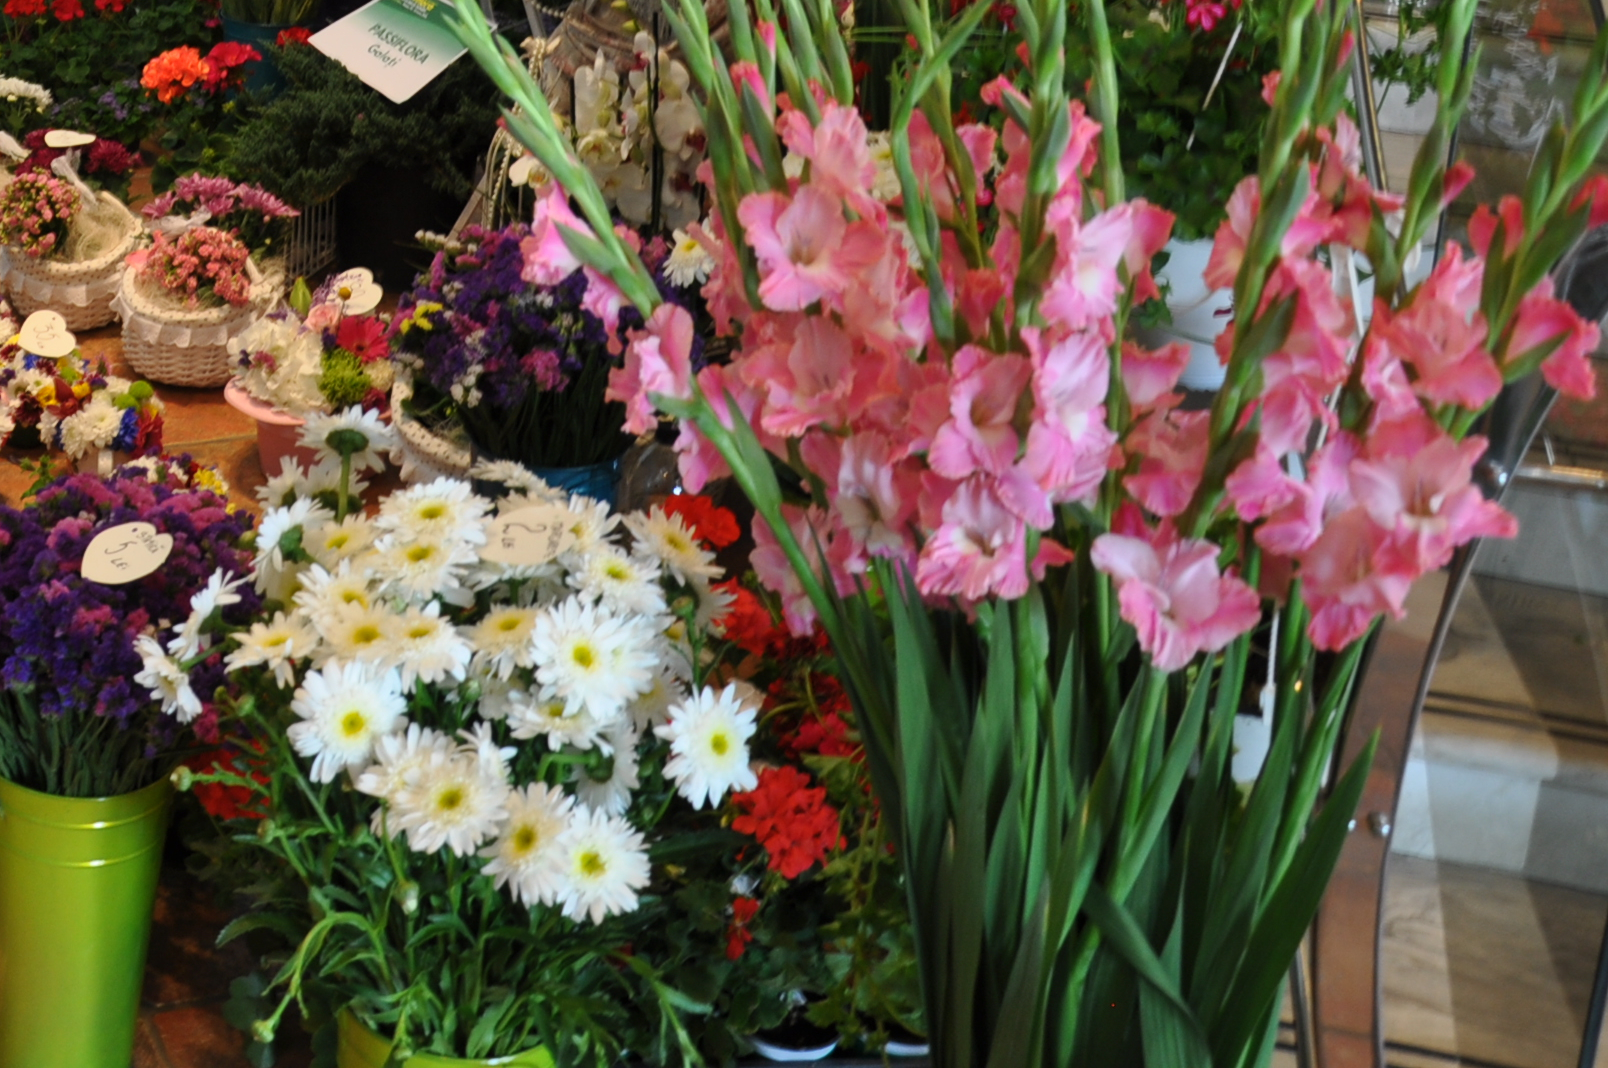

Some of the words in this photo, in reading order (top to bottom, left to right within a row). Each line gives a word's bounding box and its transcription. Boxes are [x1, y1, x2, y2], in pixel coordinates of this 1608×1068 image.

[368, 22, 430, 65] PASSIFLORA
[502, 521, 547, 535] 2
[104, 540, 138, 555] 5
